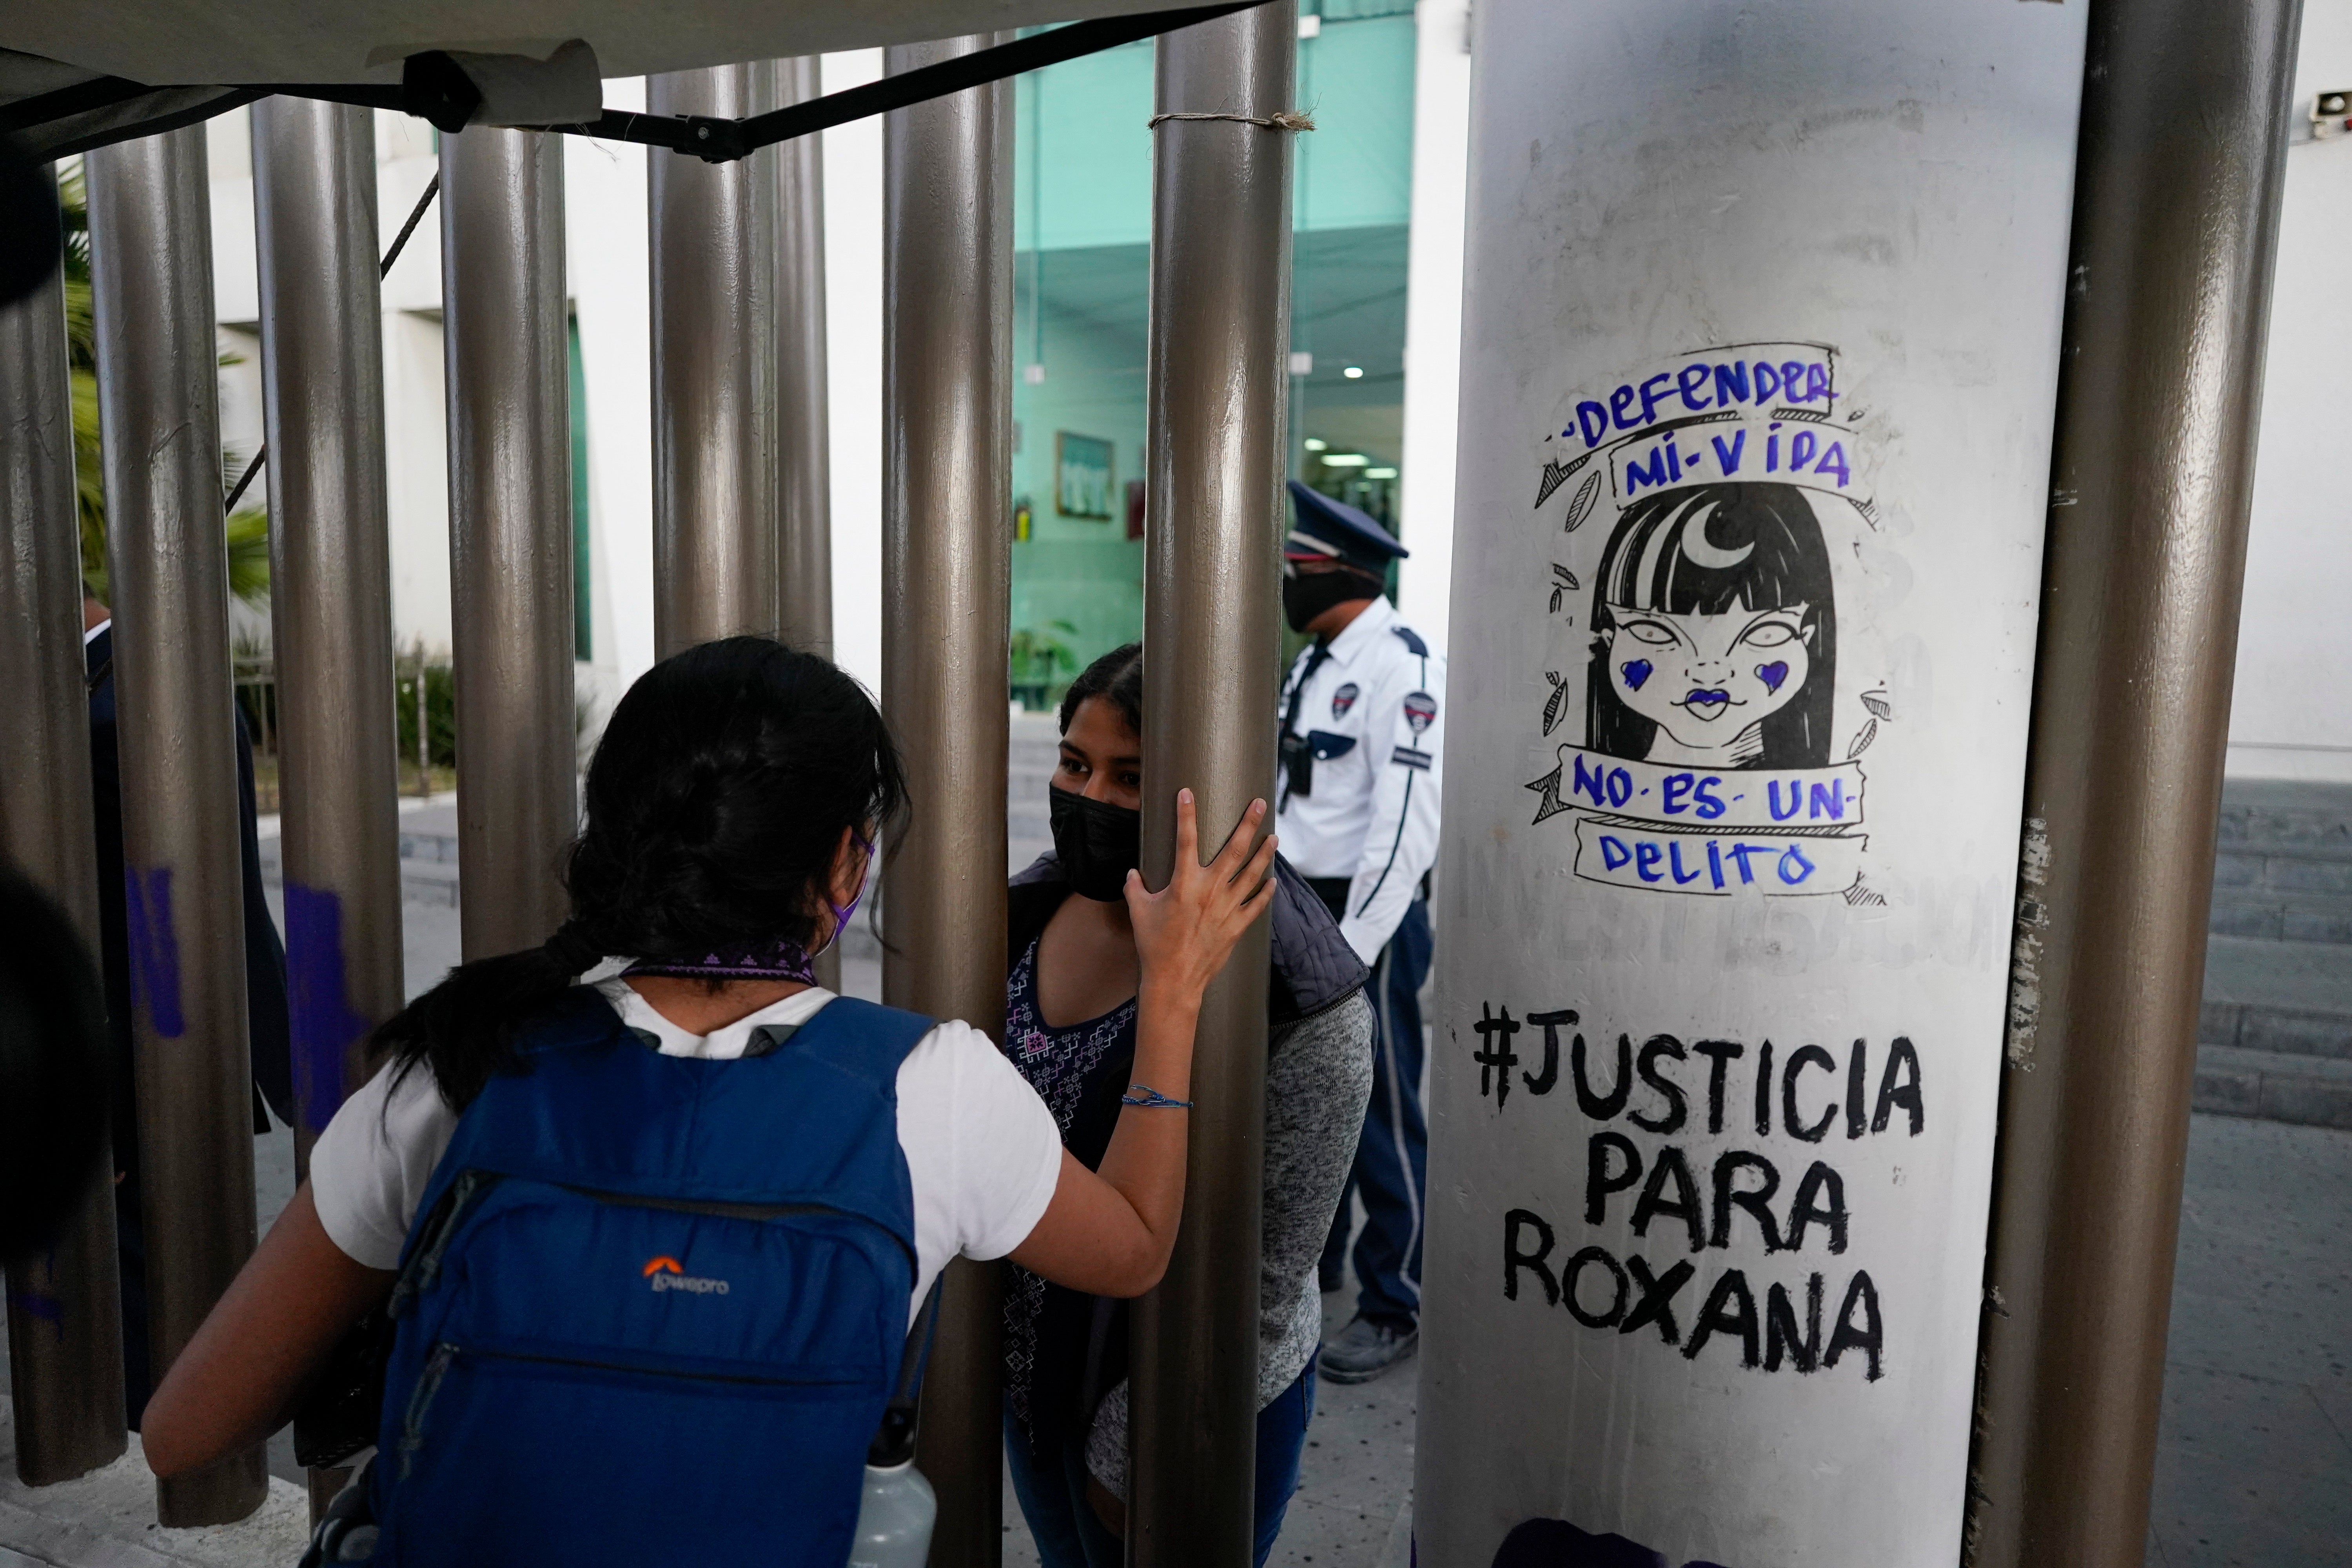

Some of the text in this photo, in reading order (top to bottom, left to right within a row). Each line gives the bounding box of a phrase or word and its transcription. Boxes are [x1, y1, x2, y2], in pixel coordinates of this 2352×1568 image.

[1473, 1000, 1924, 1144] #JUSTICIA
[1584, 1131, 1848, 1256] PARA
[1504, 1209, 1883, 1383] ROXANA
